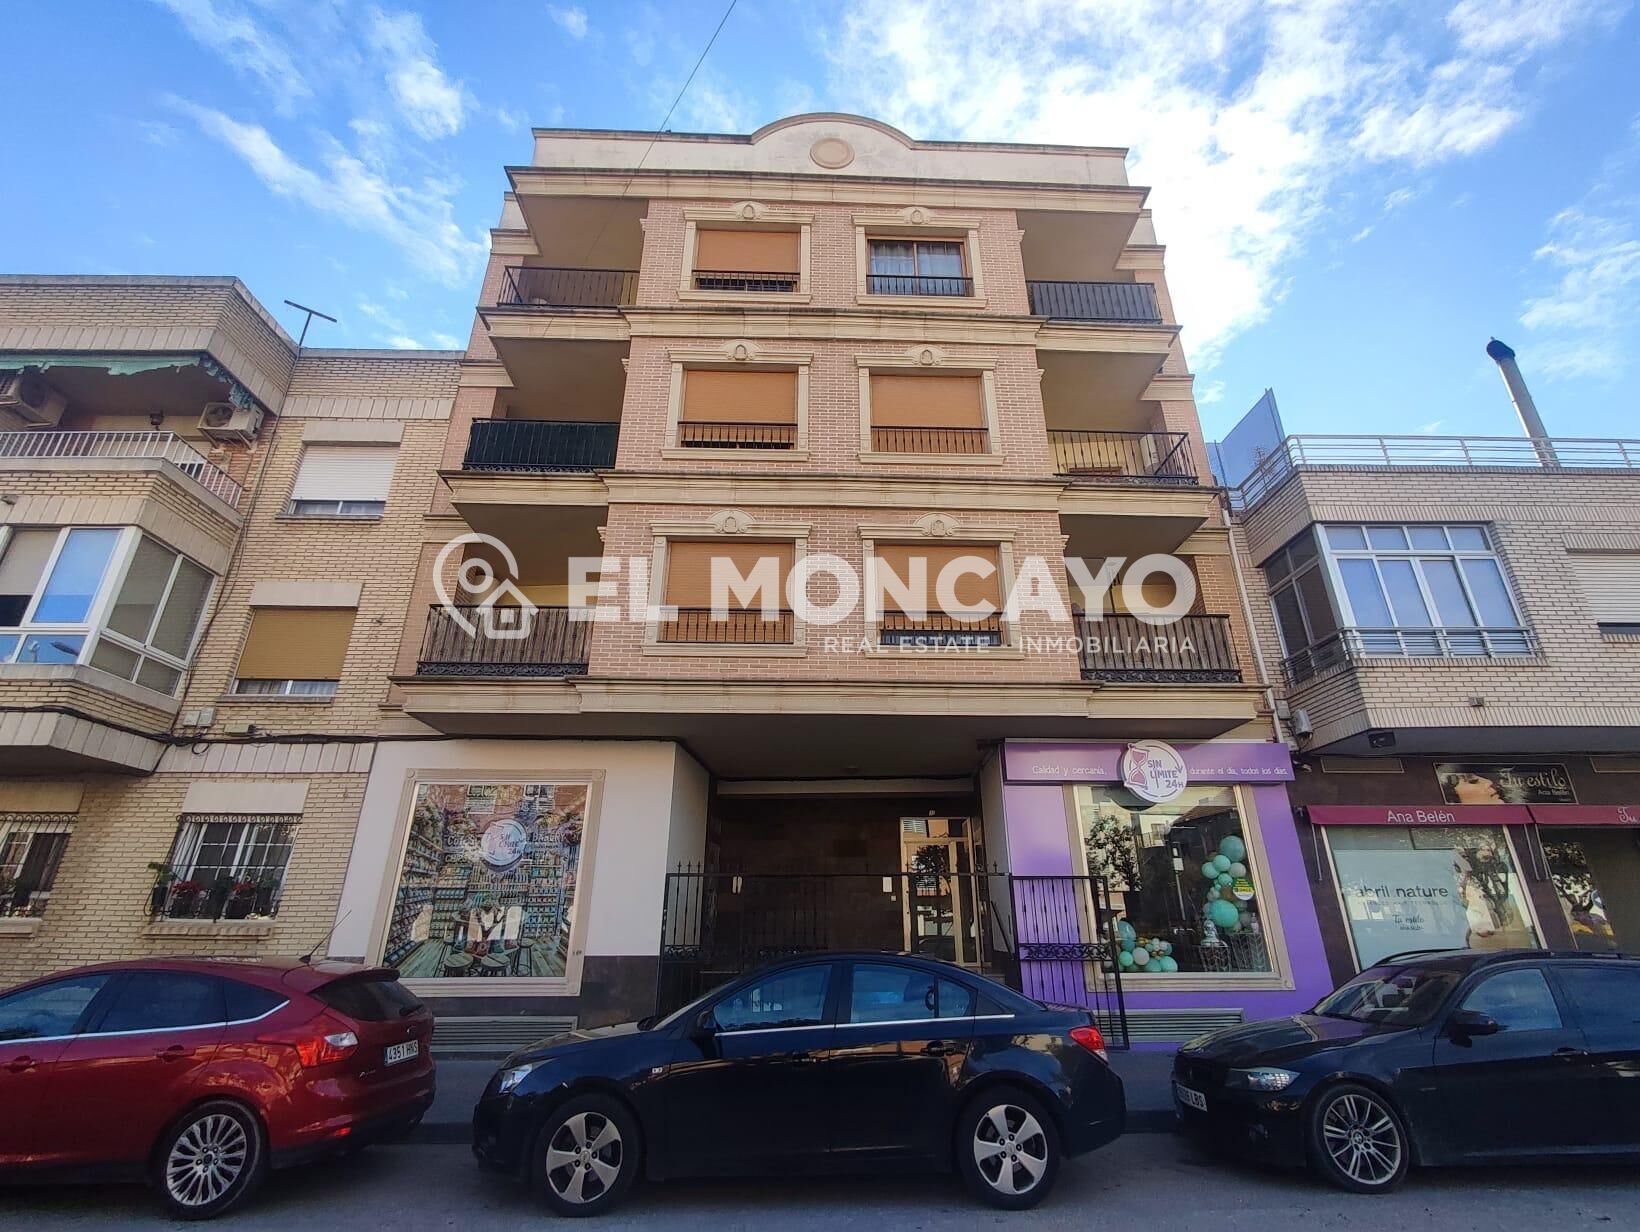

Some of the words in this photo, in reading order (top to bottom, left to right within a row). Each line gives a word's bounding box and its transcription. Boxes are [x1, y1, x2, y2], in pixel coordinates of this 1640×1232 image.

[1147, 759, 1162, 769] SIN
[1499, 766, 1524, 788] Tu
[1527, 768, 1566, 787] estilo
[1165, 780, 1184, 788] 24H
[1388, 810, 1414, 822] Ana
[1416, 810, 1455, 823] Belén
[1356, 886, 1389, 898] abril
[1396, 886, 1449, 898] nature
[388, 1044, 405, 1060] 4351
